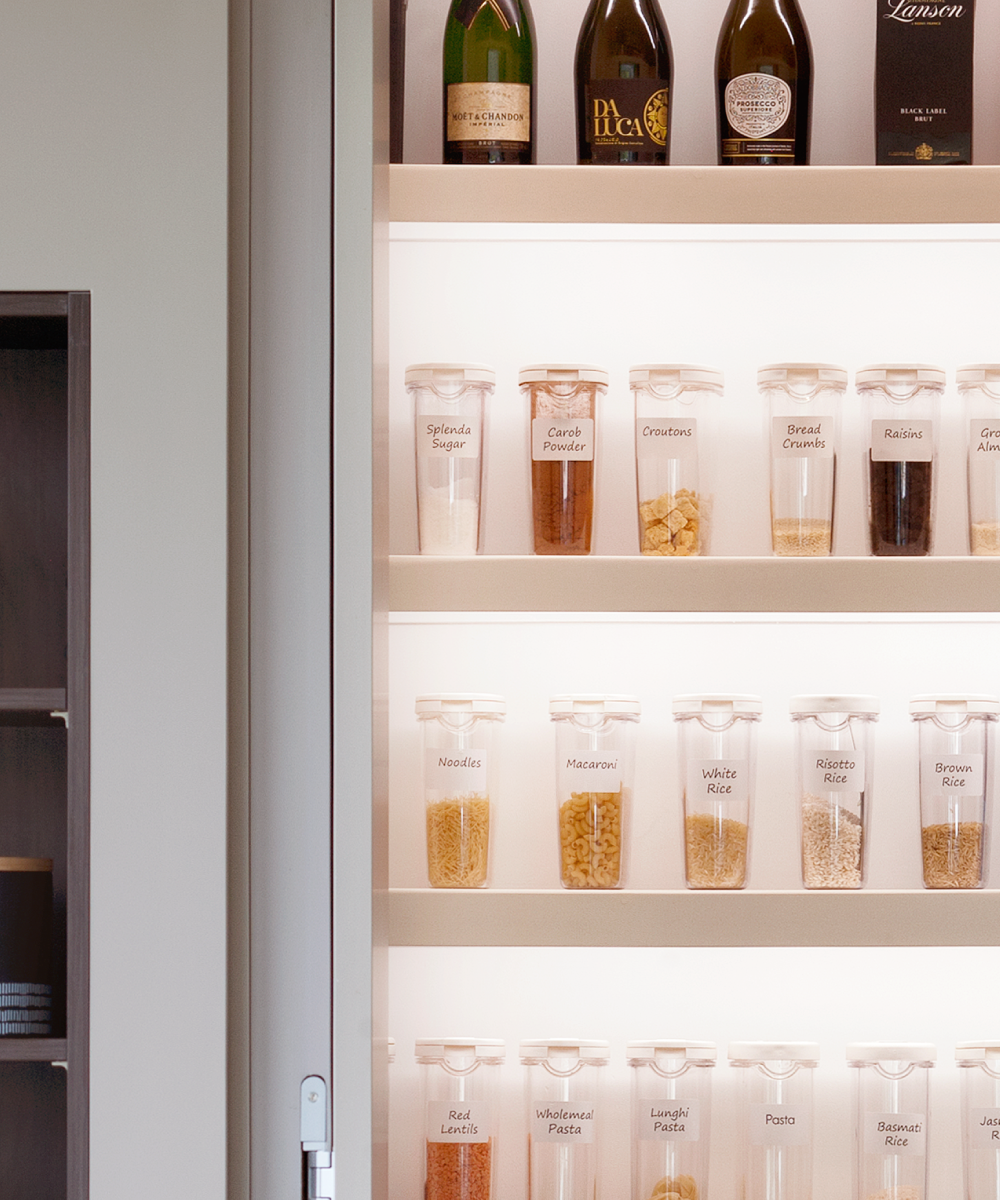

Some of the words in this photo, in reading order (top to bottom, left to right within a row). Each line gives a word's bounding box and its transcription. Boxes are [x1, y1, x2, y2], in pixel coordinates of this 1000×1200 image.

[883, 0, 967, 22] Lanson
[594, 99, 621, 117] DA
[452, 111, 473, 121] MOËT
[481, 112, 524, 121] CHANDON
[594, 118, 644, 137] LUCA
[427, 423, 470, 437] Splenda
[548, 426, 581, 437] Carob
[643, 426, 691, 436] Croutons
[788, 424, 821, 435] Bread
[885, 428, 922, 439] Raisins
[432, 439, 466, 452] Sugar
[543, 441, 586, 451] Powder
[783, 437, 825, 448] Crumbs
[438, 757, 481, 768] Noodles
[567, 759, 617, 769] Macaroni
[816, 758, 855, 769] Risotto
[935, 763, 972, 773] Brown
[702, 768, 736, 778] White
[824, 773, 847, 783] Rice
[942, 776, 965, 786] Rice
[707, 783, 731, 793] Rice
[449, 1110, 470, 1120] Red
[536, 1109, 593, 1120] Wholemeal
[651, 1108, 689, 1121] Lunghi
[766, 1114, 795, 1125] Pasta
[441, 1124, 478, 1134] Lentils
[549, 1123, 581, 1134] Pasta
[654, 1122, 685, 1132] Pasta
[878, 1121, 922, 1133] Basmati
[885, 1135, 908, 1146] Rice
